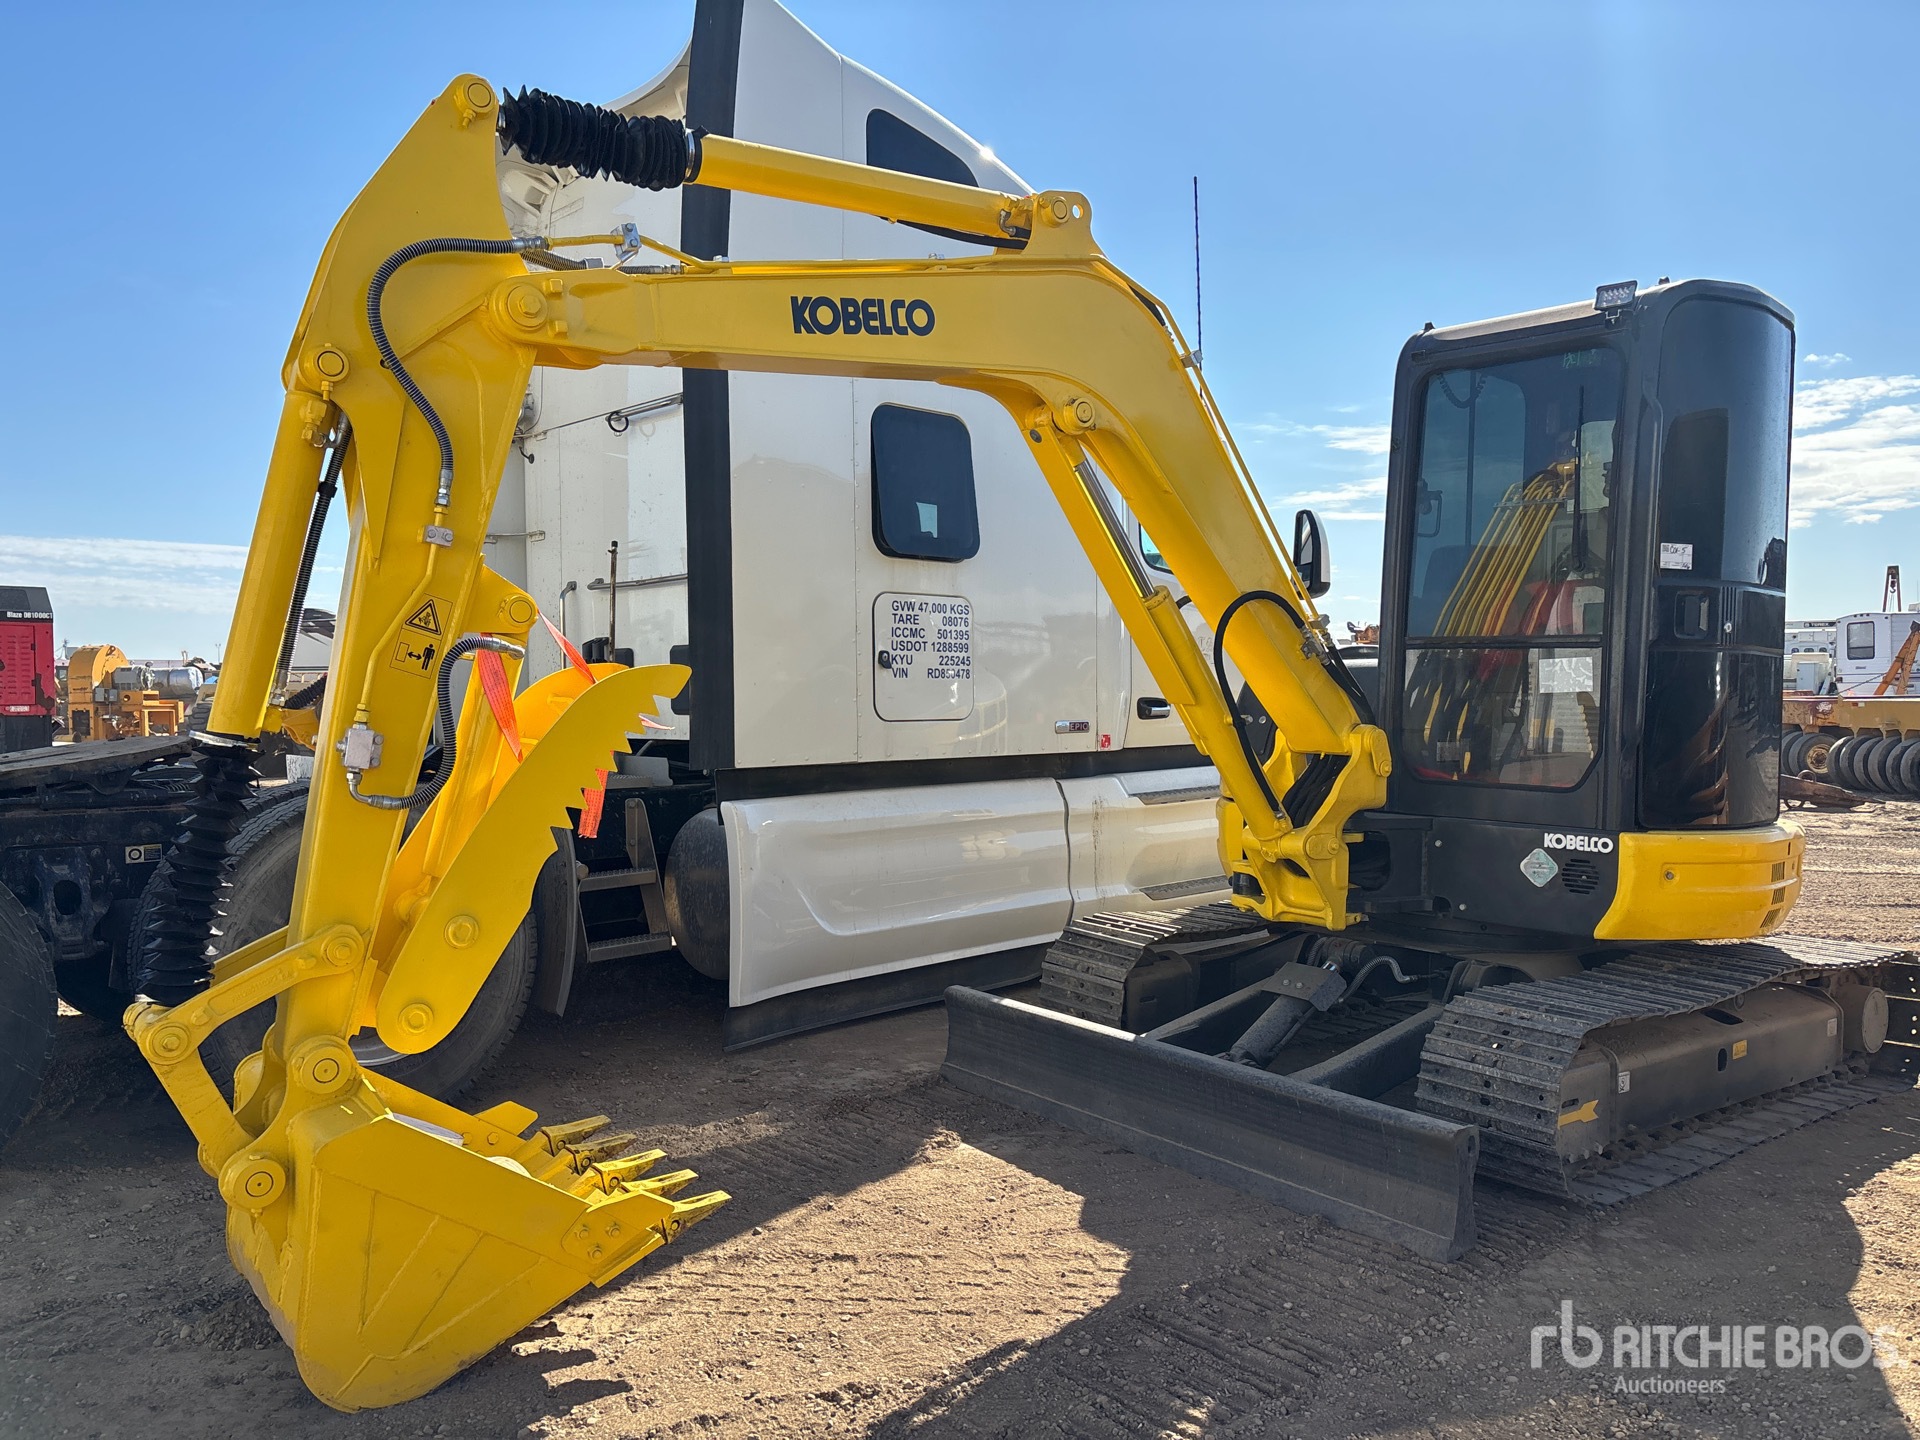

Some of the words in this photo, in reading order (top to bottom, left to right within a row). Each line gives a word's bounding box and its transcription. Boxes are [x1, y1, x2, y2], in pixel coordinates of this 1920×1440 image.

[790, 295, 936, 337] KOBELCO
[891, 600, 916, 613] GVW
[917, 602, 948, 615] 47,000
[949, 604, 970, 615] KGS
[891, 613, 920, 625] TARE
[941, 616, 970, 628] 08076
[891, 626, 926, 639] ICCMC
[936, 628, 970, 641] 501395
[891, 640, 928, 652] USDOT
[930, 641, 969, 653] 1288599
[891, 654, 913, 666] KYU
[938, 655, 971, 667] 225245
[891, 667, 909, 679] VIN
[1543, 832, 1614, 854] KOBELCO
